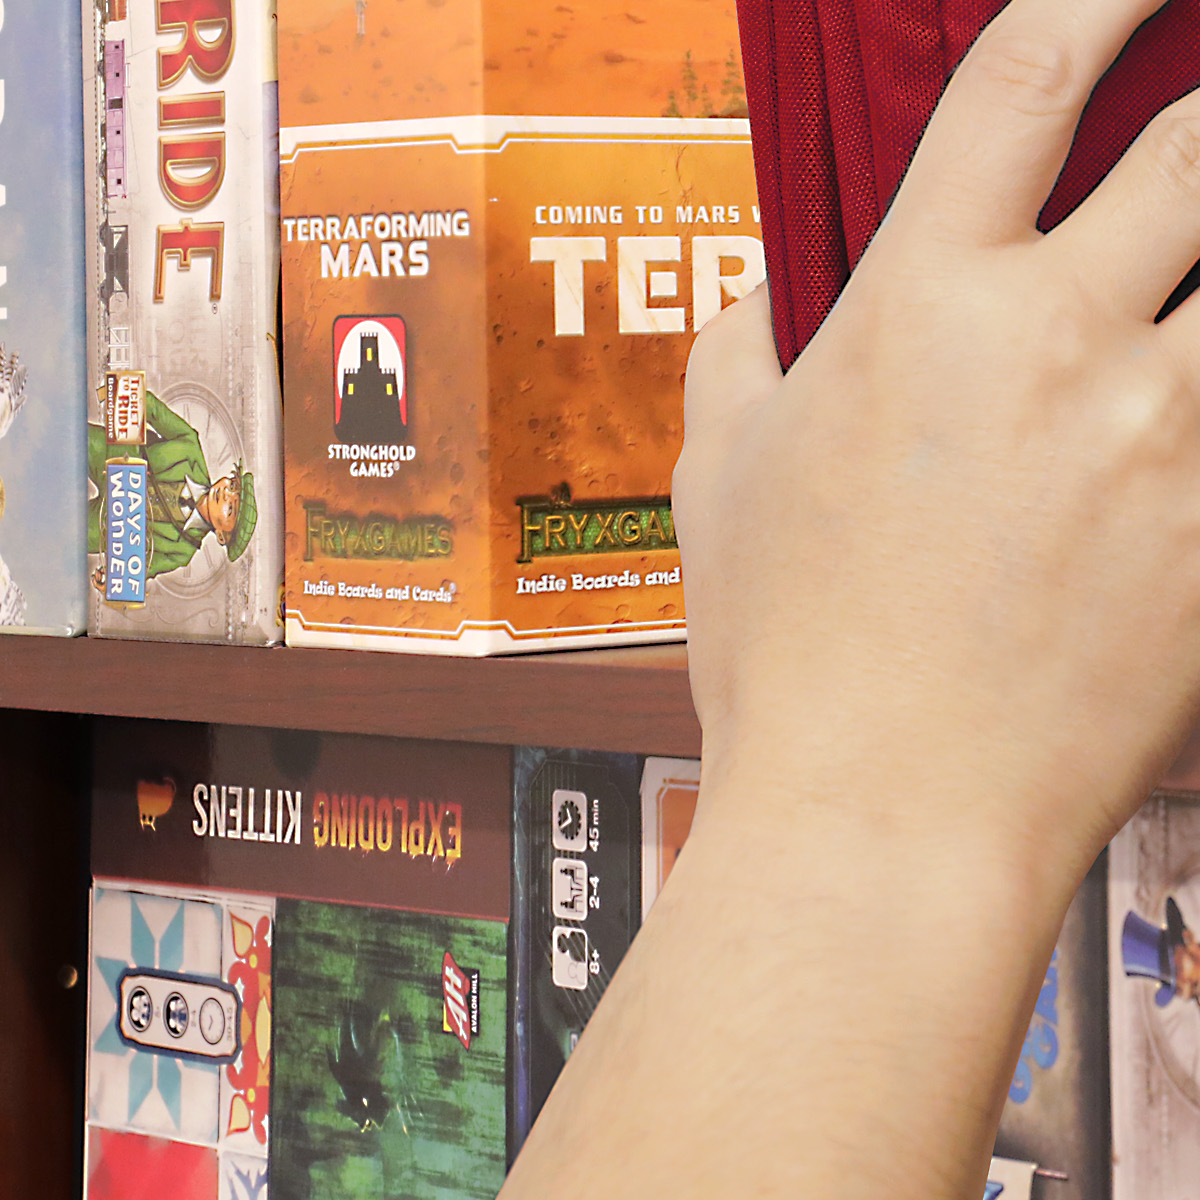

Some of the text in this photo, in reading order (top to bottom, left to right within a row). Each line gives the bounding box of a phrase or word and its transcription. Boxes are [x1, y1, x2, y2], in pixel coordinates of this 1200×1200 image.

[283, 210, 470, 242] TERRAFORMING
[534, 205, 623, 225] COMING
[635, 205, 663, 224] TO
[676, 205, 740, 224] MARS
[320, 239, 430, 279] MARS
[106, 377, 116, 439] Boardgame
[117, 376, 130, 440] TO RIDE
[129, 376, 140, 427] TICKET
[328, 444, 417, 462] STRONGHOLD
[126, 471, 143, 596] DAYS OF
[303, 502, 453, 562] FRYXGAMES
[303, 580, 335, 597] Indie
[338, 582, 383, 599] Boards
[385, 585, 411, 601] and
[516, 566, 681, 595] Indie Boards and
[192, 783, 462, 862] EXPLODING KITTENS
[589, 799, 600, 853] 45 min
[589, 875, 600, 910] 2-4
[589, 949, 600, 976] 8+
